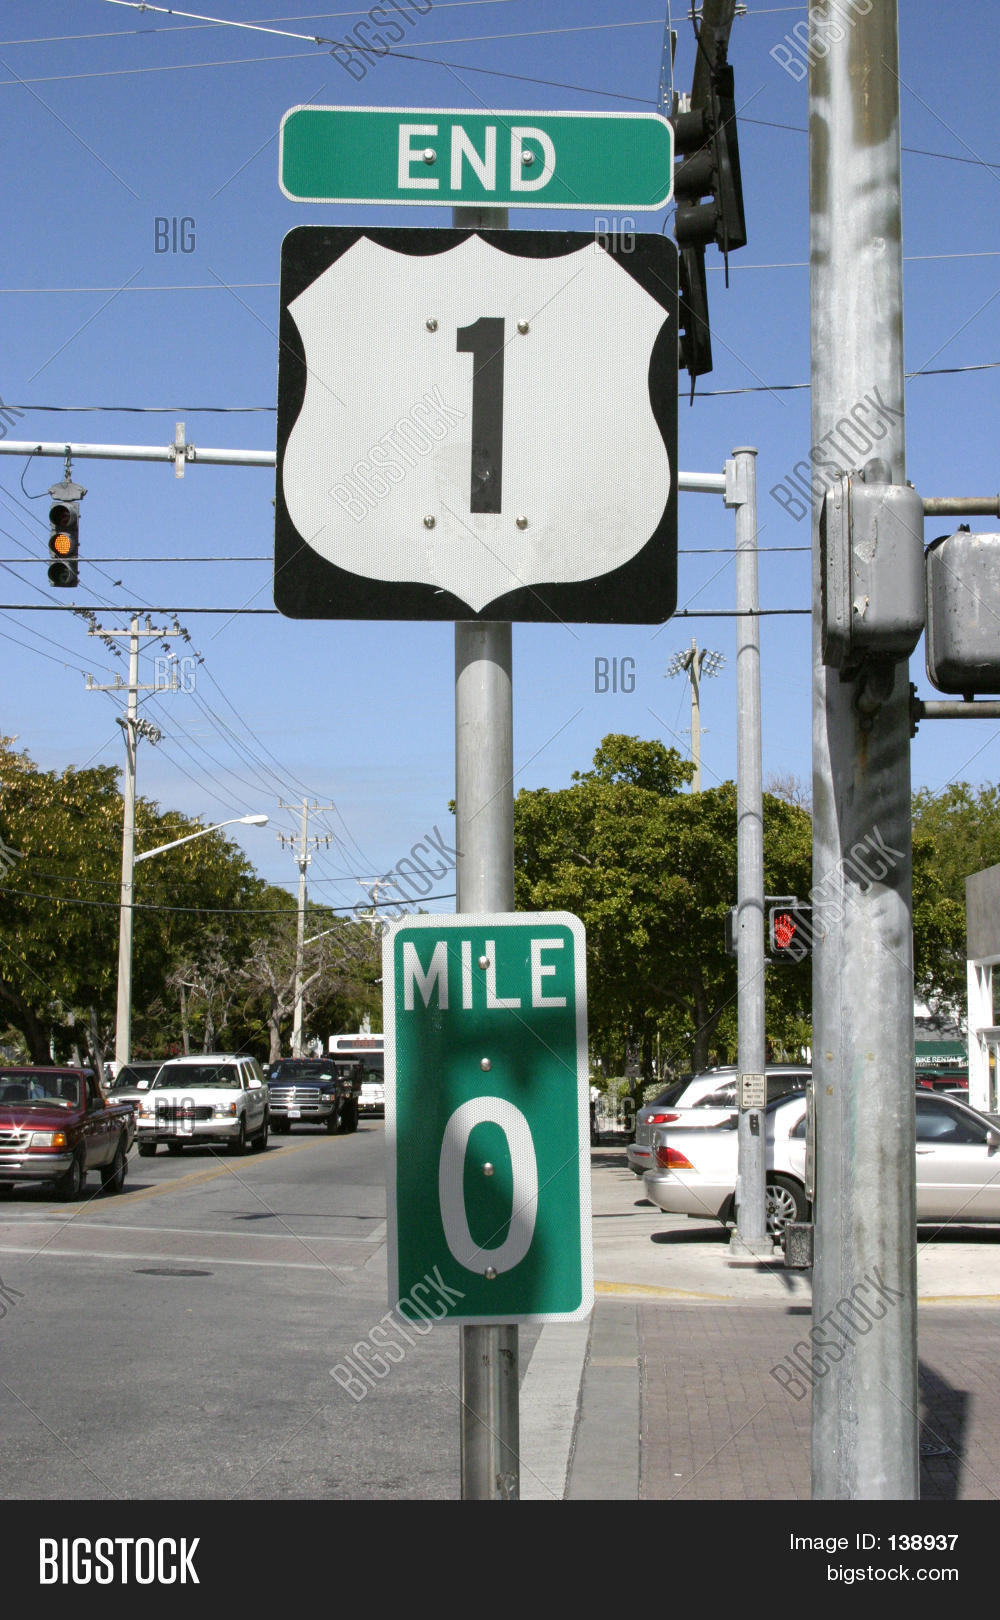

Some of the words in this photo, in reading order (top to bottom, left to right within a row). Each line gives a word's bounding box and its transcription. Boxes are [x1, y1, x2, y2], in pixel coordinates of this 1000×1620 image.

[397, 124, 557, 193] END
[456, 317, 505, 514] 1
[402, 939, 568, 1011] MILE
[439, 1096, 539, 1273] 0
